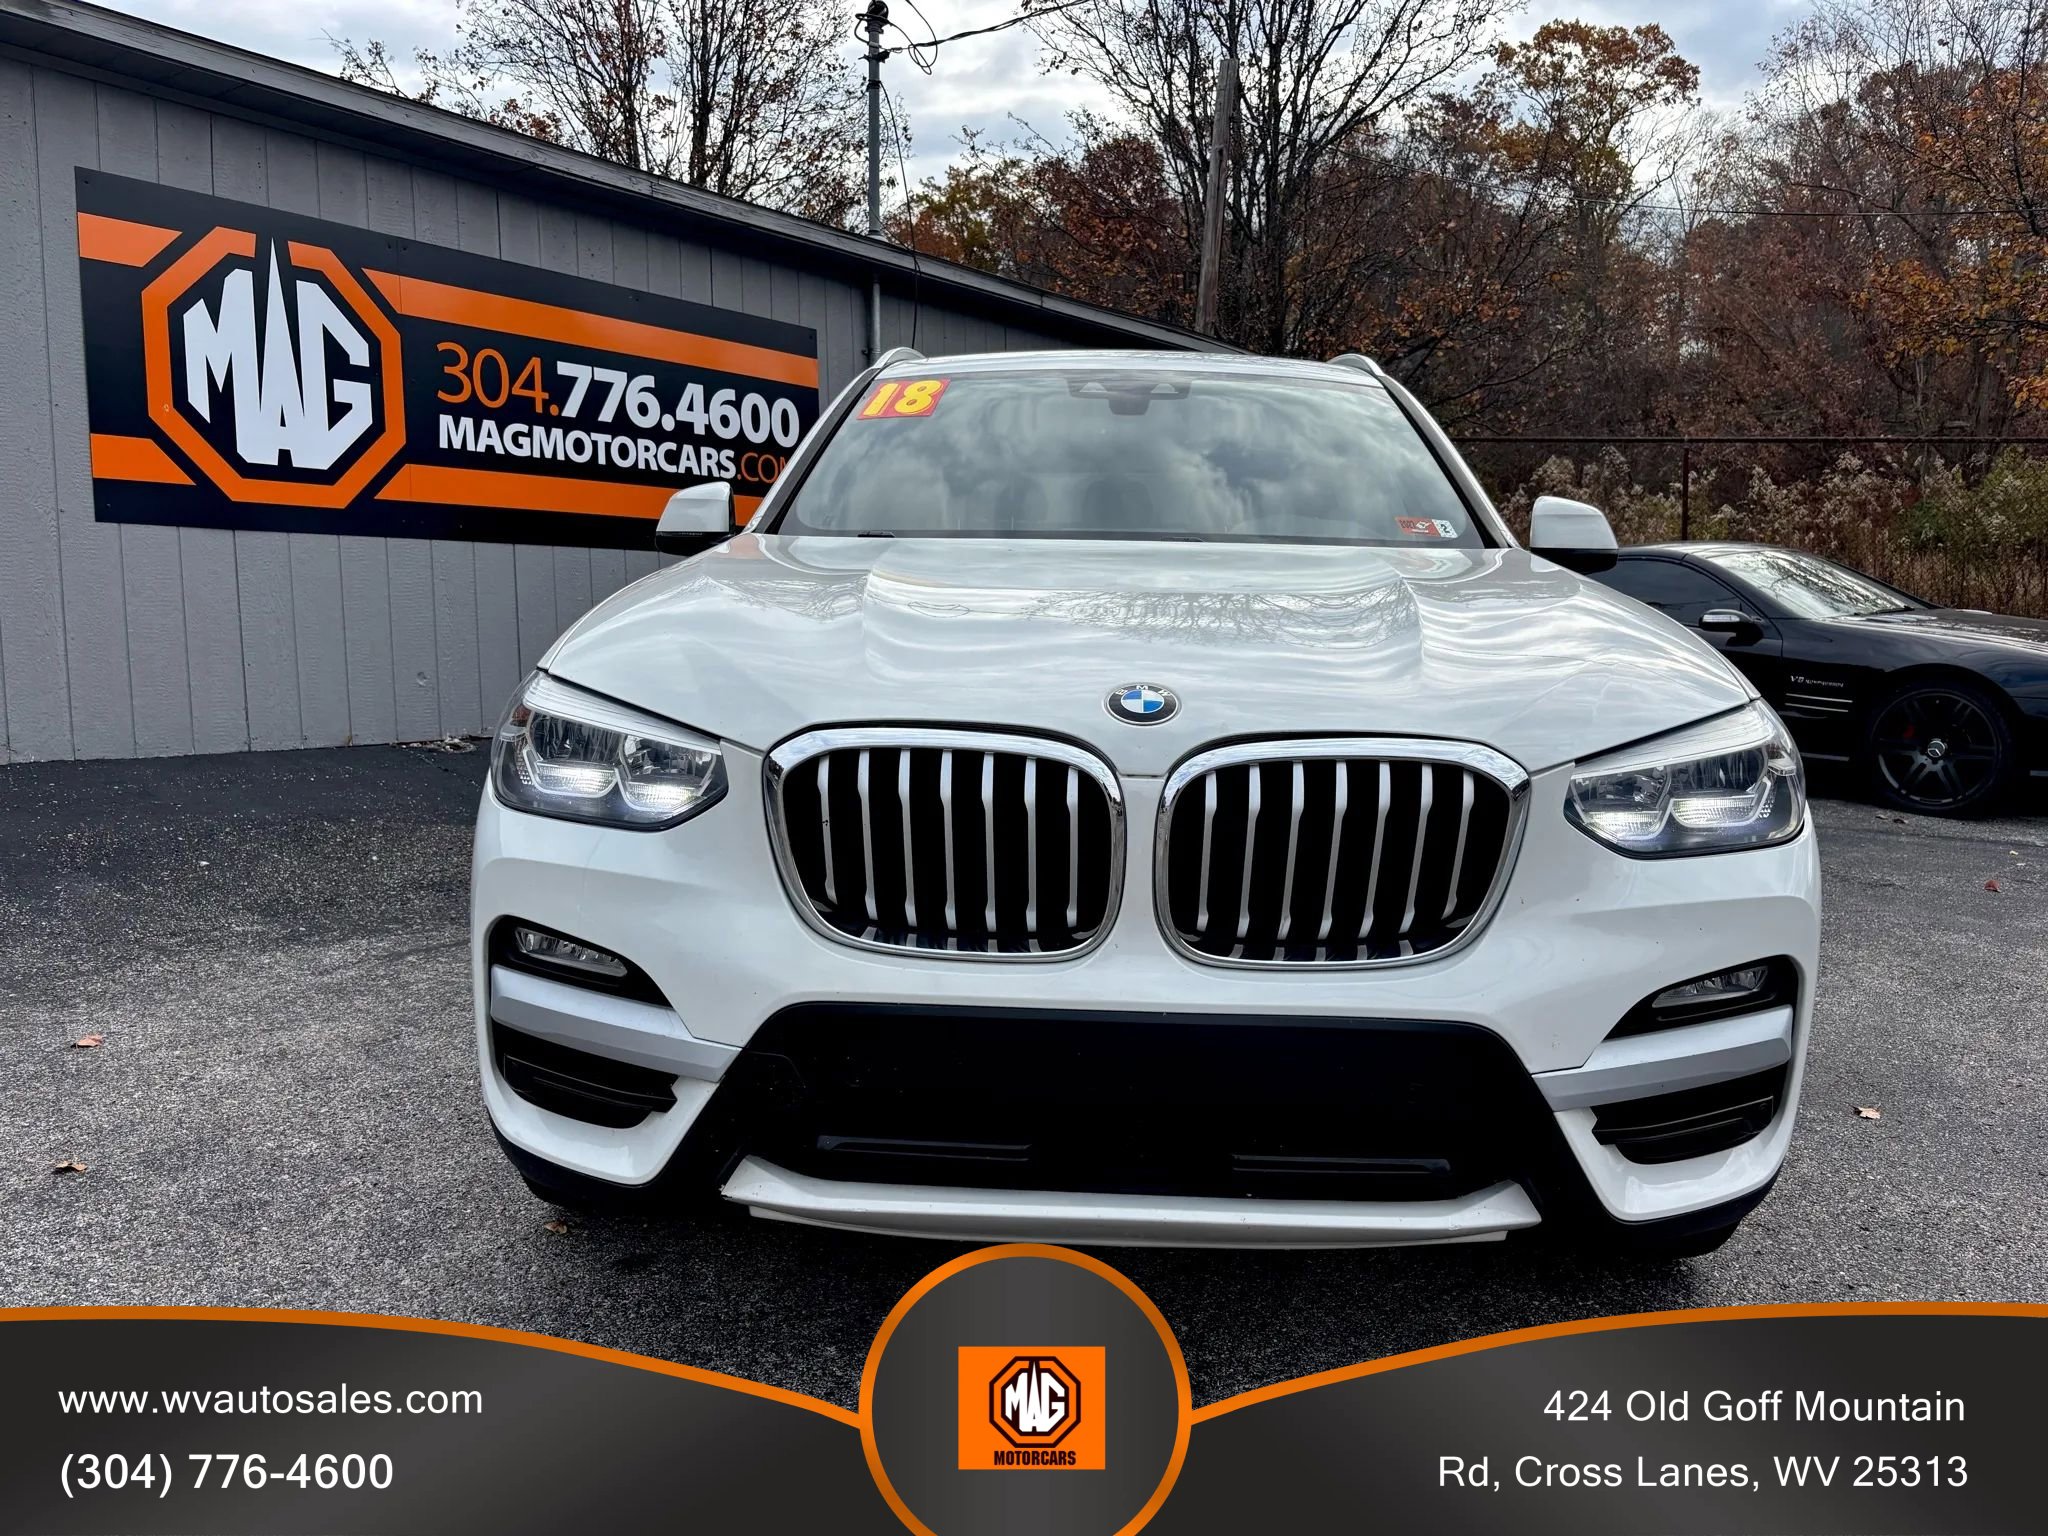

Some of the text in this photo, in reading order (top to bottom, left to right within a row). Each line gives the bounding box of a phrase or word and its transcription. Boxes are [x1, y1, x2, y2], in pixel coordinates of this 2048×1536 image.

[183, 237, 372, 470] MAG
[436, 342, 799, 448] 304.776.4600
[862, 380, 944, 416] 18
[1114, 684, 1172, 697] BMW
